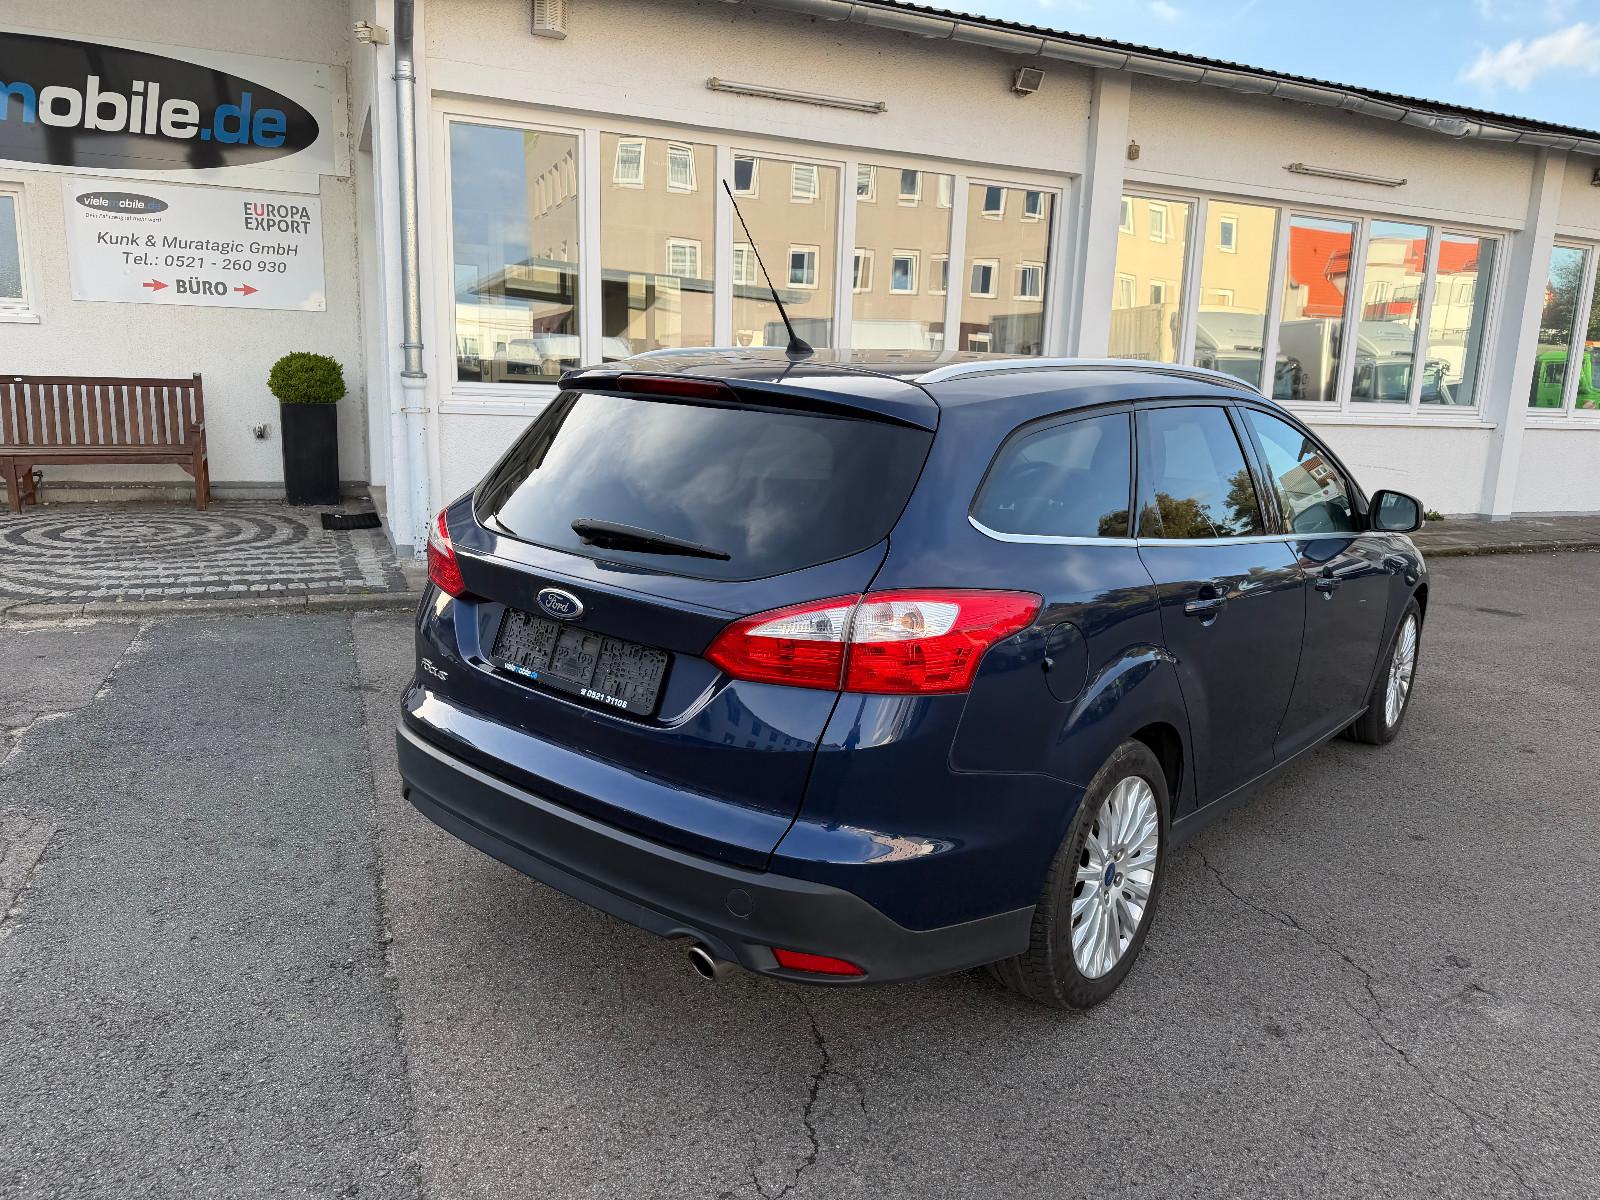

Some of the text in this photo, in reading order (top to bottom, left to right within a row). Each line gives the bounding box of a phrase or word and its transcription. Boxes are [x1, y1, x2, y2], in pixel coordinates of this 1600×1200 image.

[244, 202, 310, 220] EUROPA
[245, 217, 310, 234] EXPORT
[97, 231, 299, 256] Kunk & Muratagic GmbH
[122, 252, 159, 266] Tel.:
[164, 255, 204, 269] 0521
[222, 258, 251, 271] 260
[257, 261, 287, 273] 930
[176, 276, 228, 296] BÜRO
[545, 593, 570, 612] Ford
[586, 690, 605, 701] 0521
